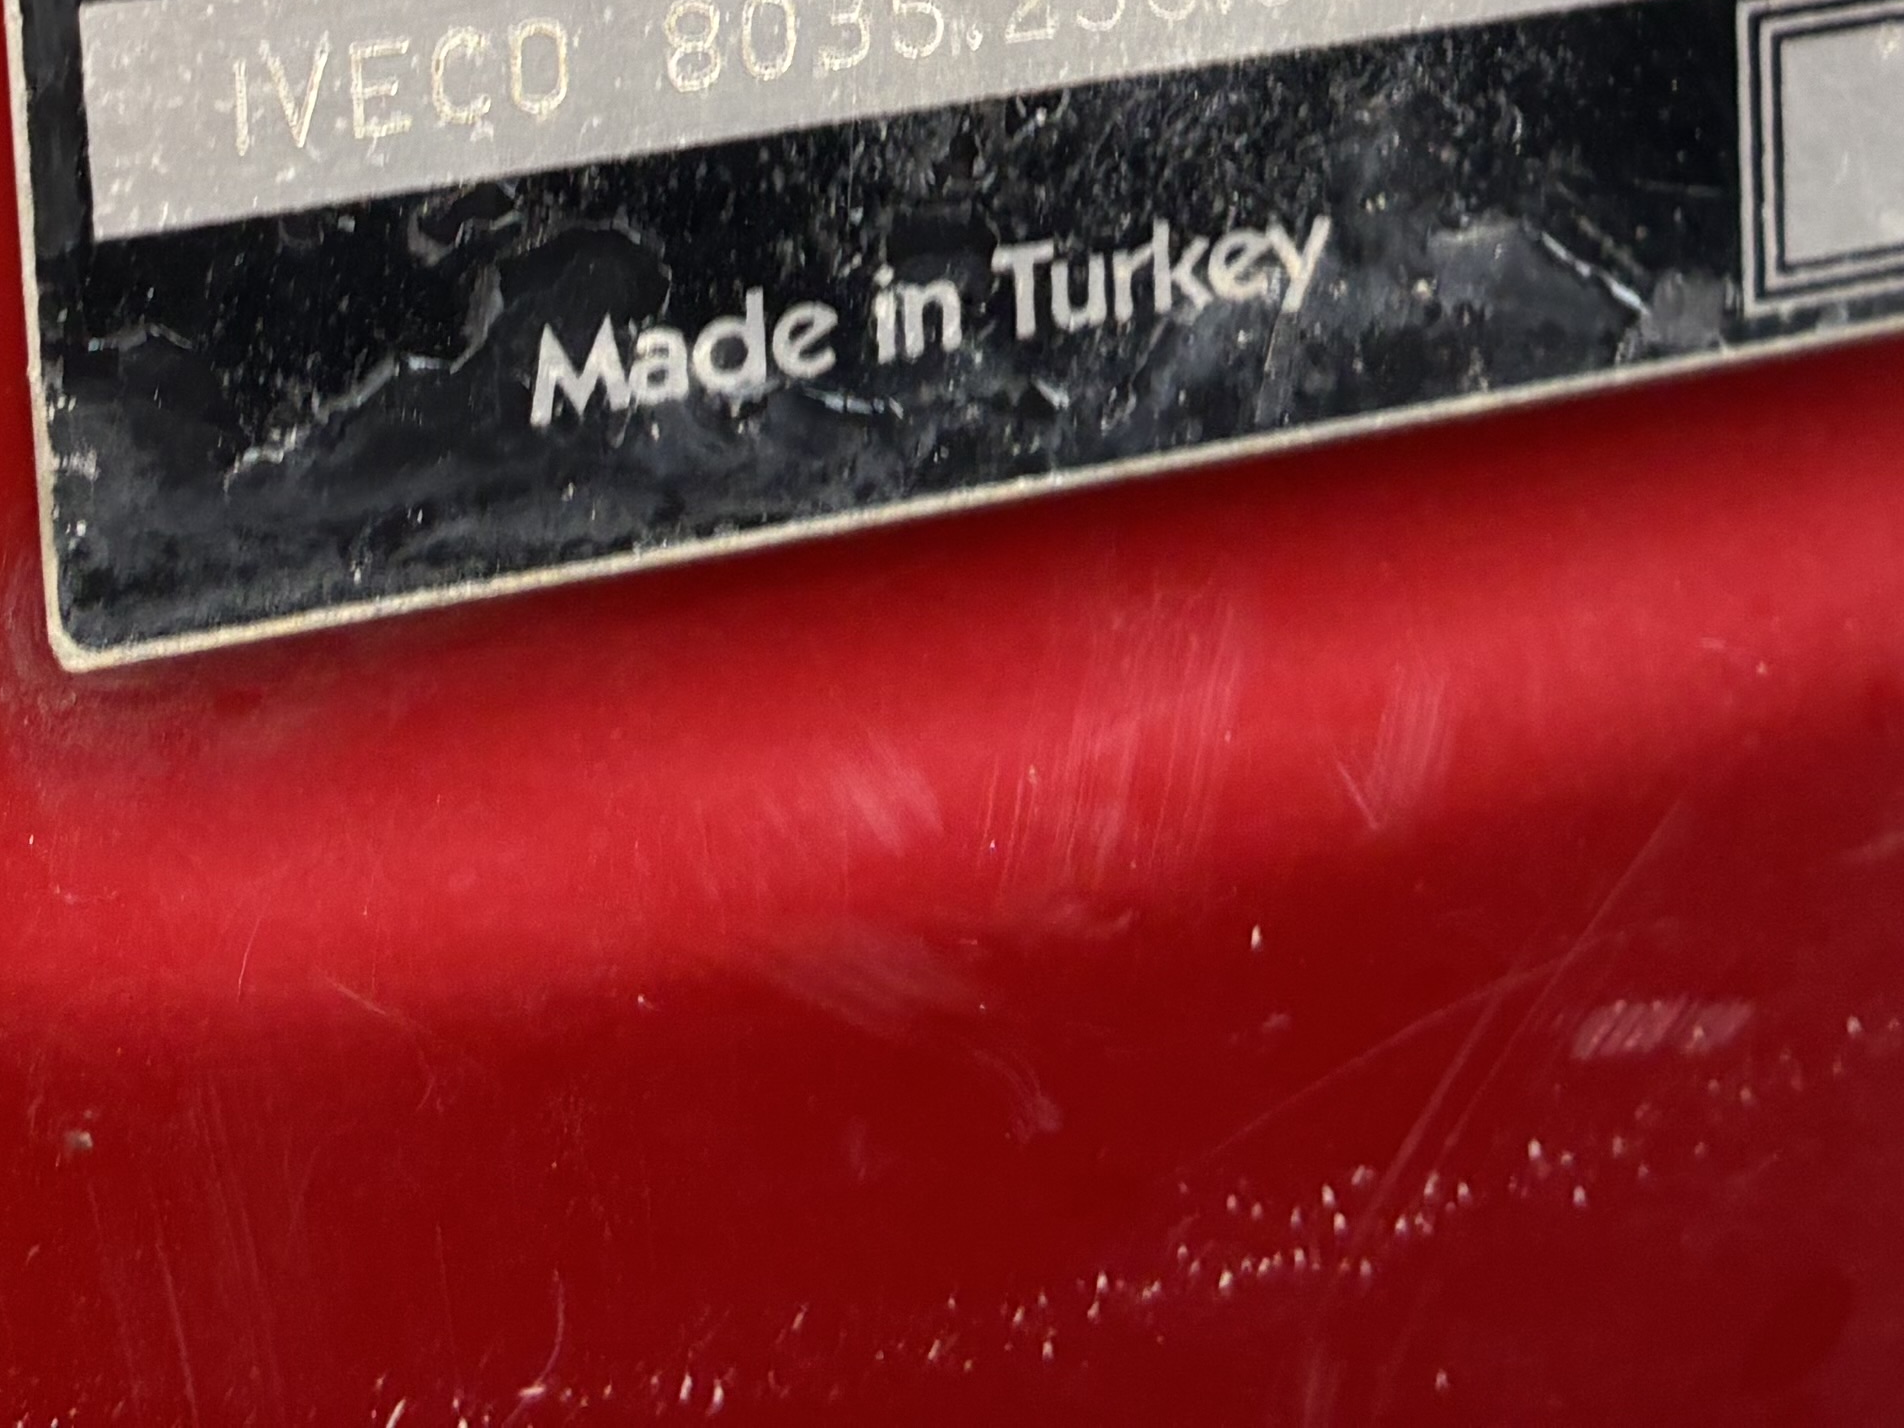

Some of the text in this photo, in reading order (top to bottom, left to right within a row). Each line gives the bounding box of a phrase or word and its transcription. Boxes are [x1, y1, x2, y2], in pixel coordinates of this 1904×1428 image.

[231, 16, 572, 157] IVECO
[530, 214, 1333, 427] Made in Turkey
